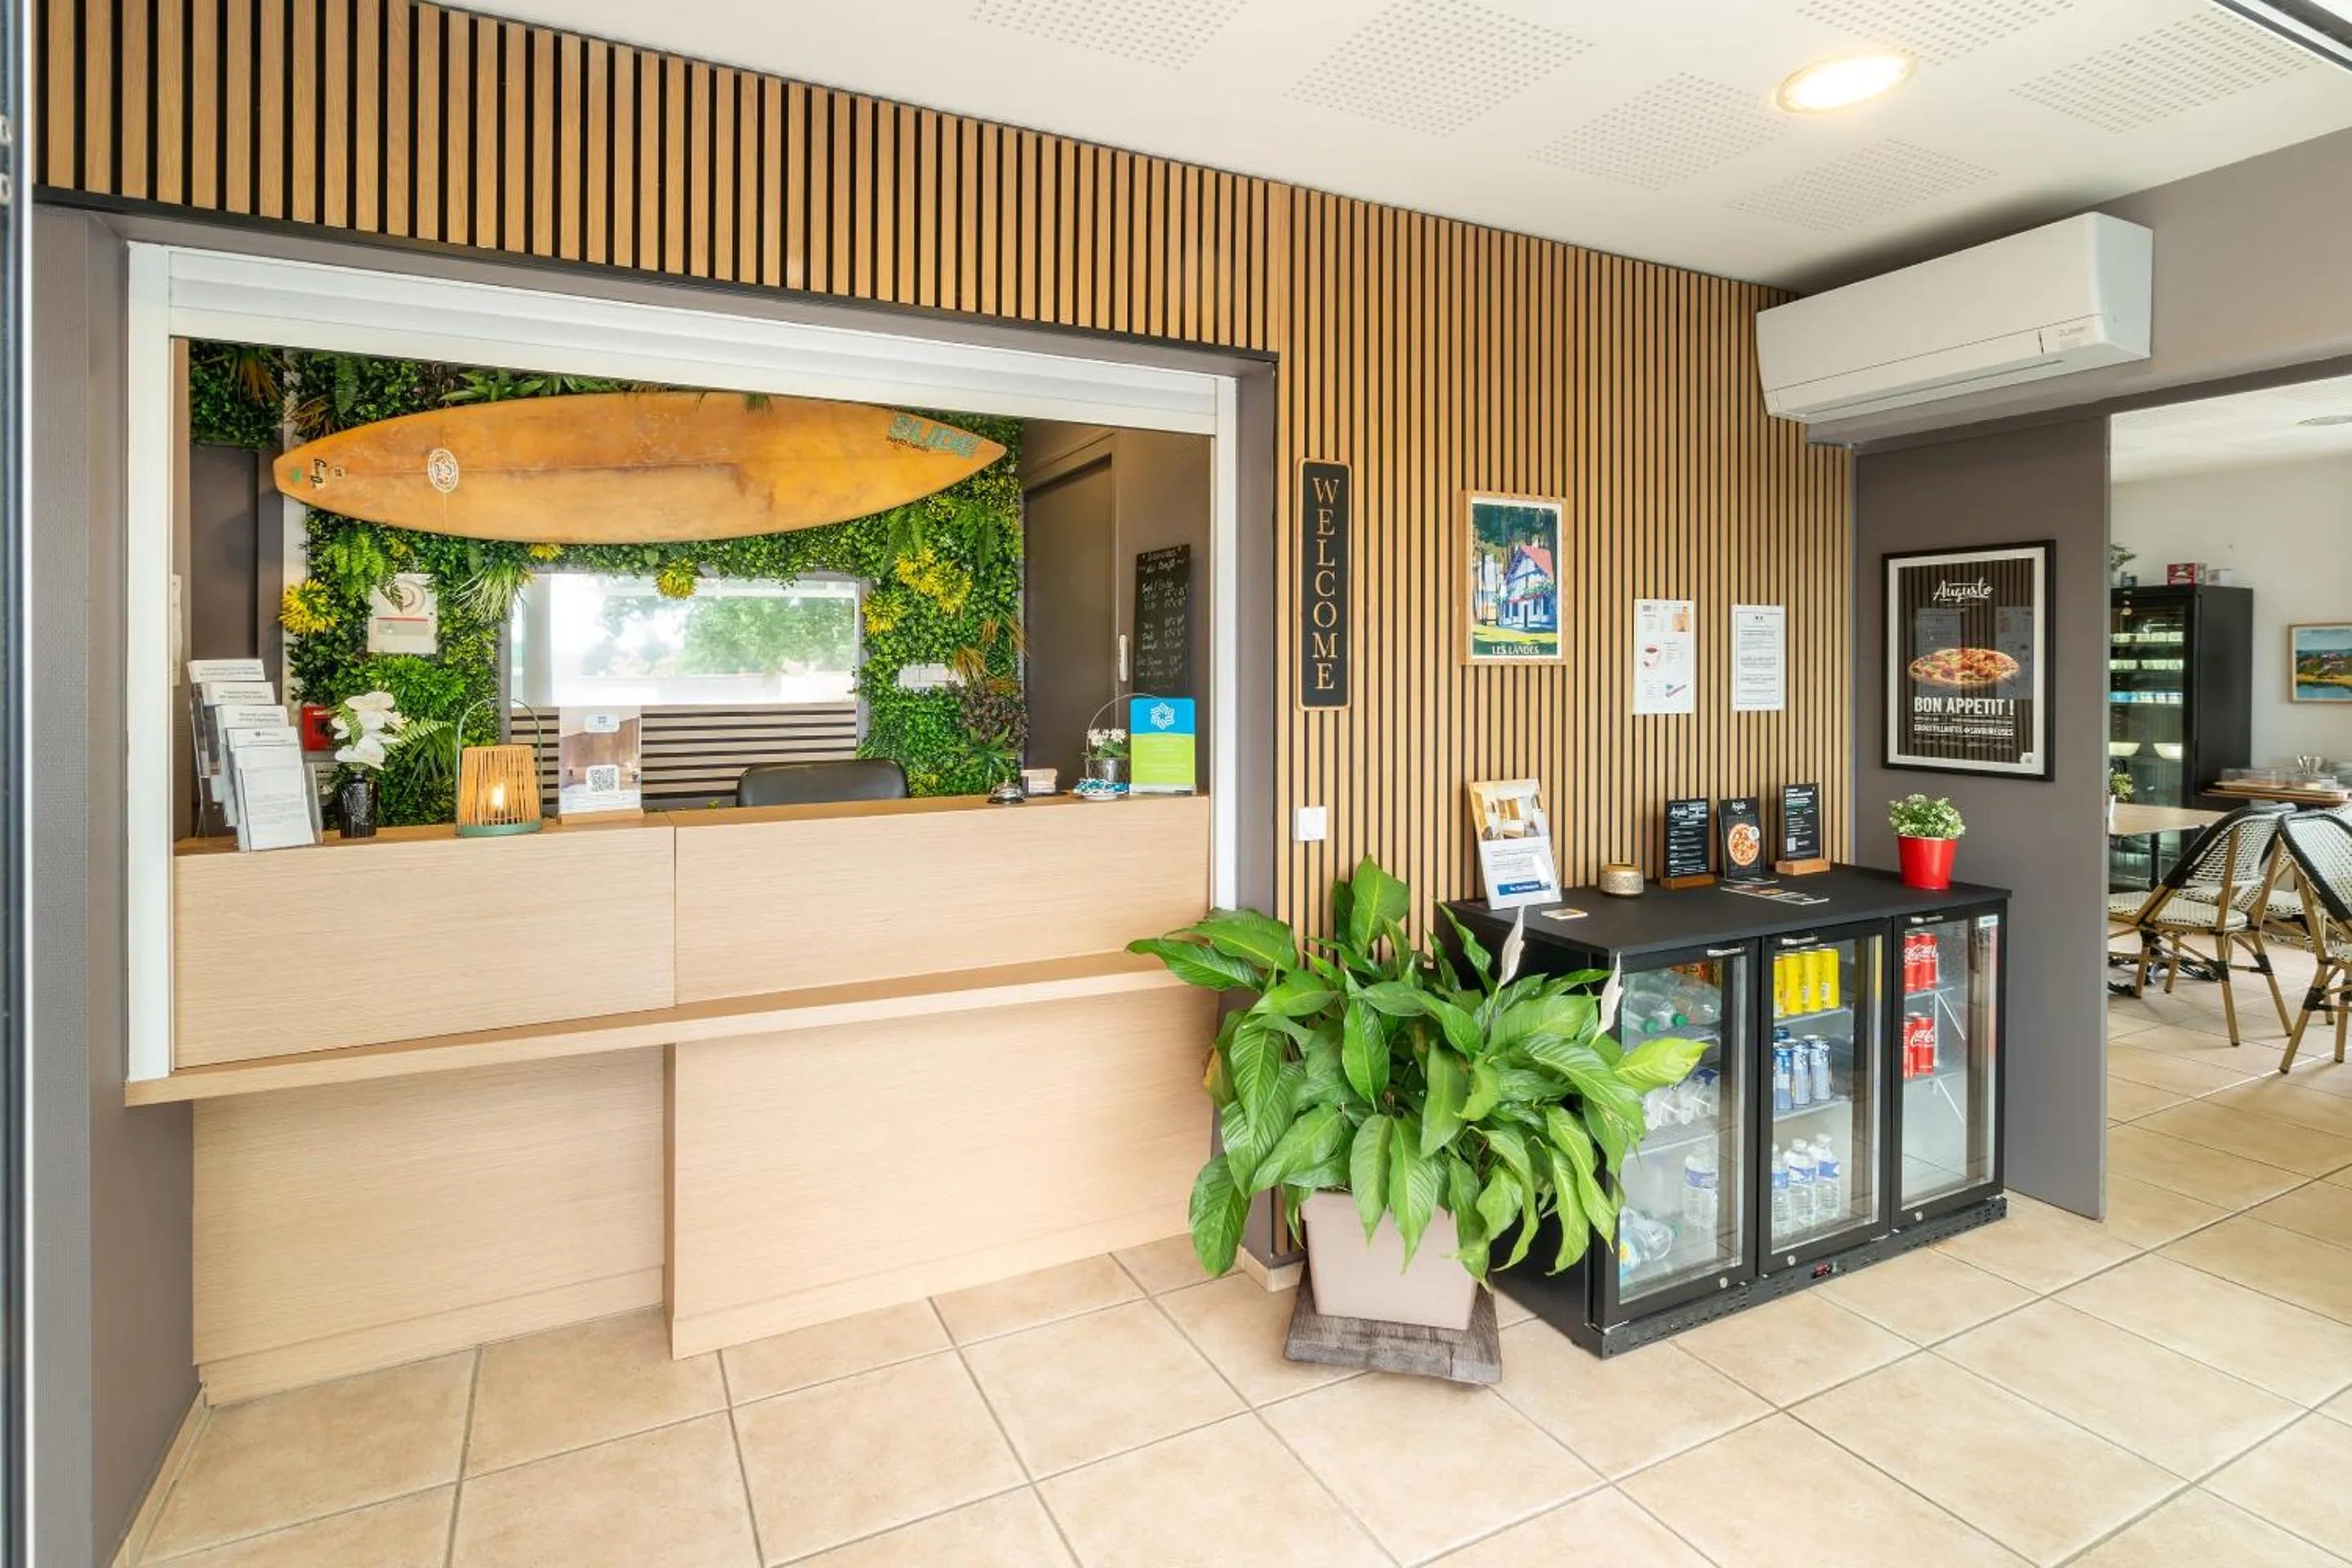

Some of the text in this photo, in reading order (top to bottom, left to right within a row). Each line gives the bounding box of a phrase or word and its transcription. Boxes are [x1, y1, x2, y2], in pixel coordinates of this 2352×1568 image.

[1312, 477, 1339, 689] WELCOME
[1492, 645, 1539, 655] LES LANDES
[1913, 697, 1942, 713] BON
